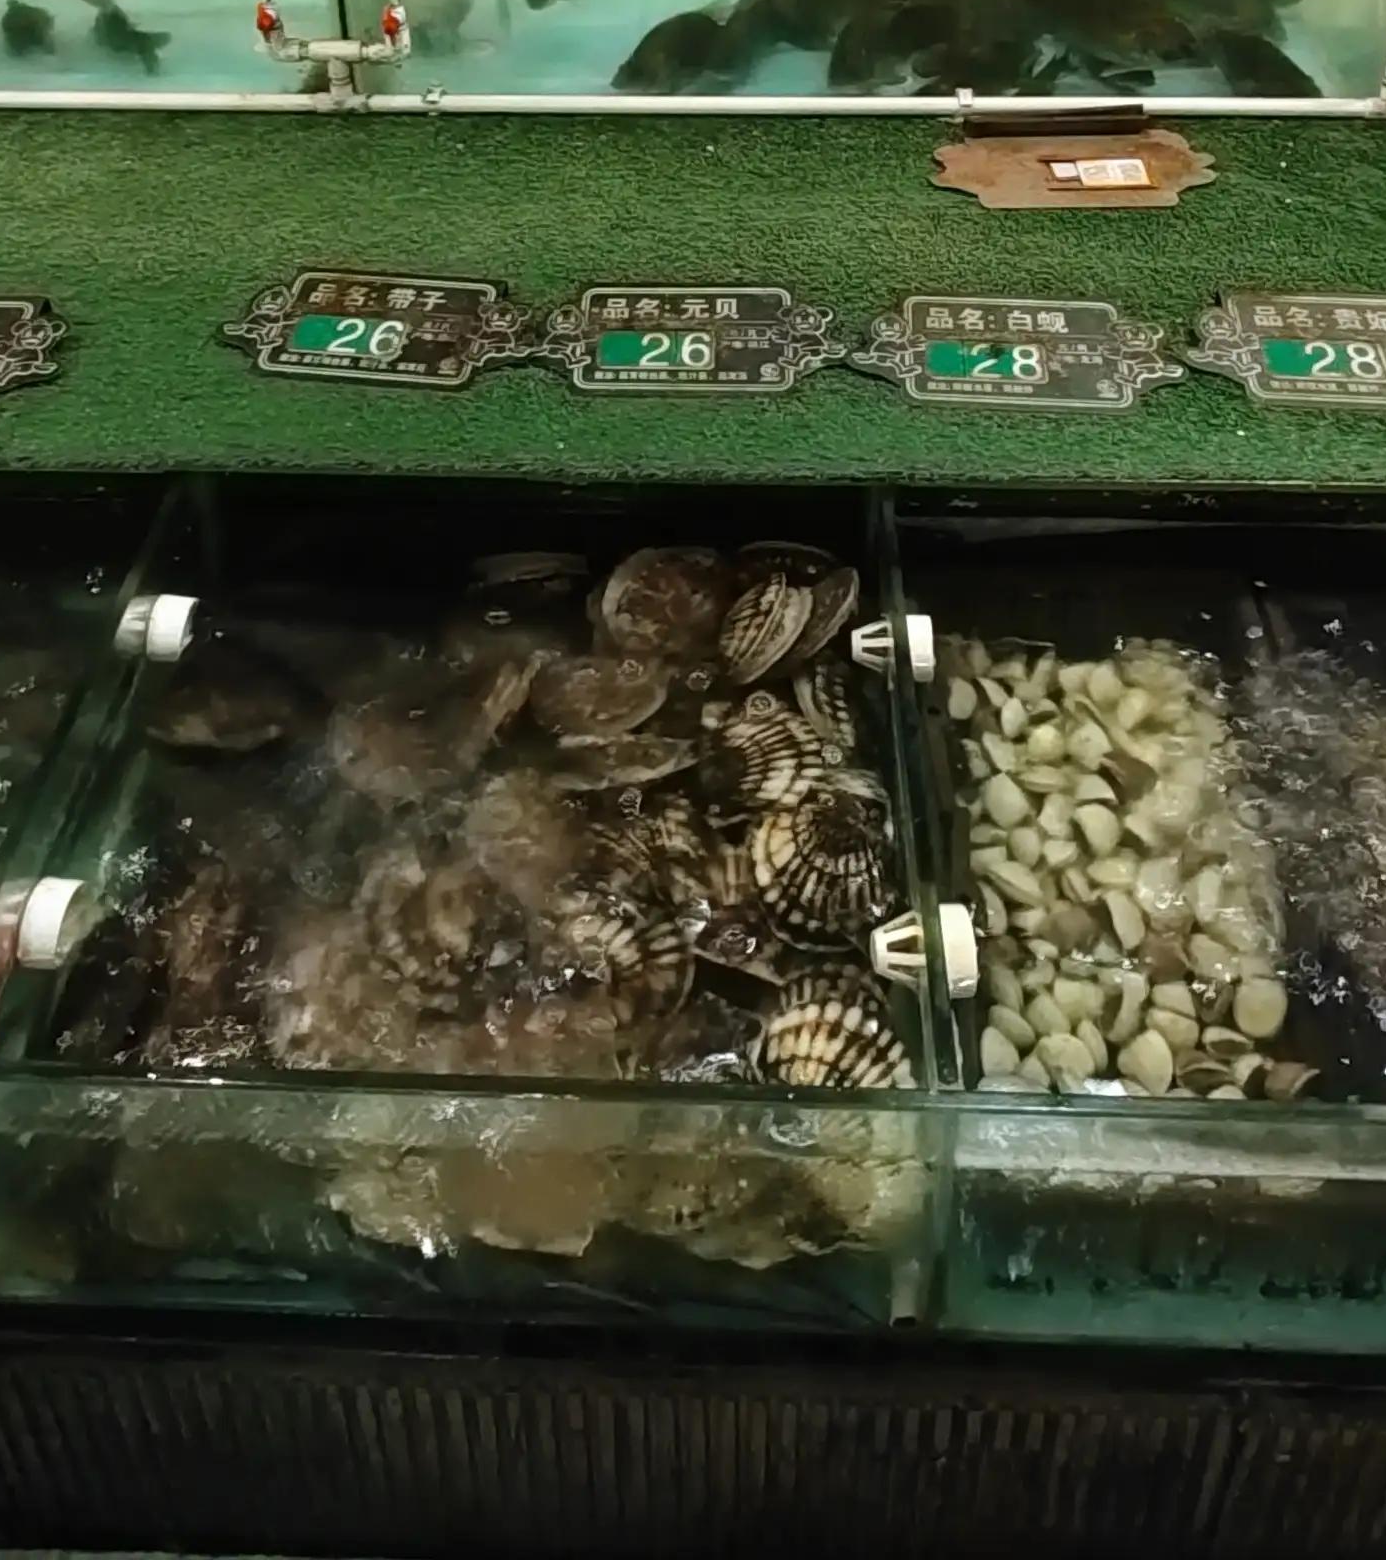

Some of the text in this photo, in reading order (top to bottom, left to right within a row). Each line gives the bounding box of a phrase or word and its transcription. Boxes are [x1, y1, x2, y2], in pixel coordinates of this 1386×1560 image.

[308, 283, 448, 311] 品名：带子
[602, 297, 740, 320] 品名：元贝
[327, 318, 404, 355] 26
[926, 306, 1069, 334] 品名：白蚬
[639, 332, 711, 367] 26
[971, 344, 1043, 380] 28
[1304, 341, 1383, 379] 28
